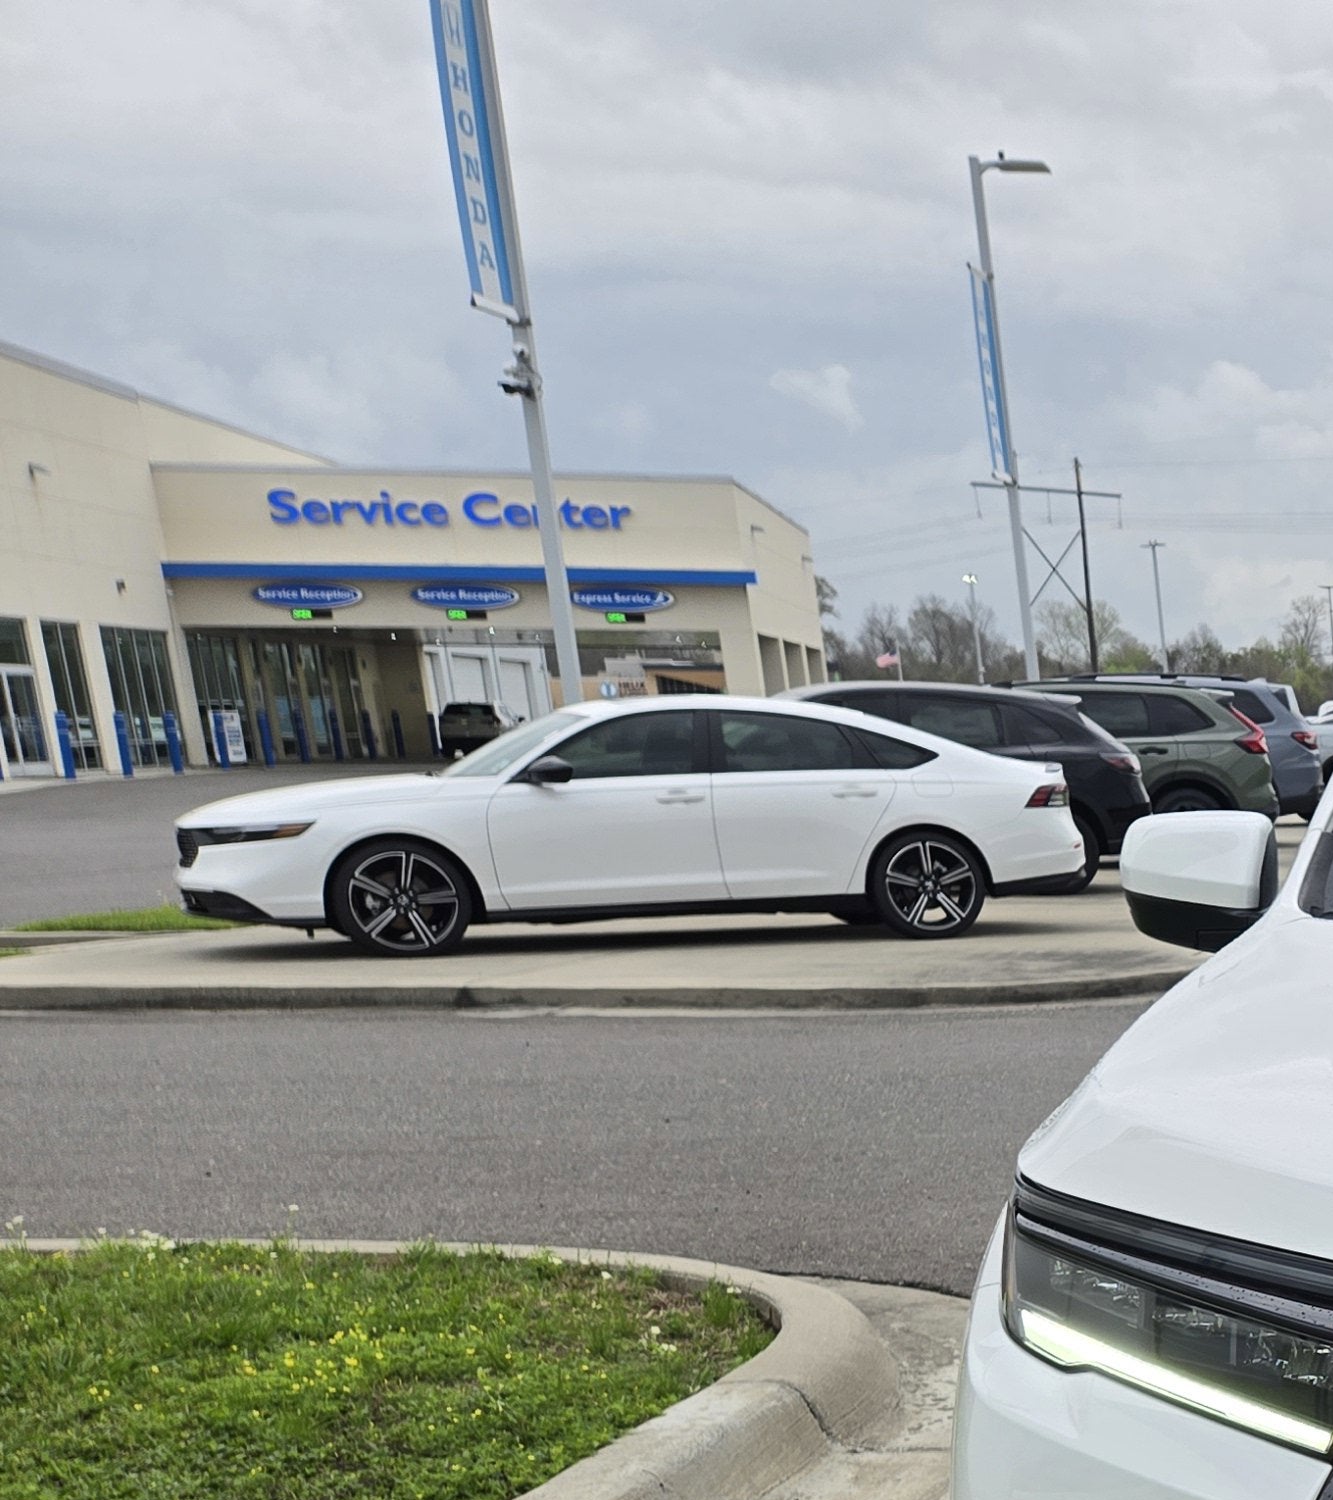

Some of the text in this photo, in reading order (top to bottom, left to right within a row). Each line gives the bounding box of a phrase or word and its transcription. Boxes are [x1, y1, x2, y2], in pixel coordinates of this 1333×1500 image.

[450, 63, 496, 271] HONDA
[266, 488, 632, 530] Service Ceter
[258, 587, 355, 601] Service Reception
[417, 588, 511, 602] Service Reception
[613, 592, 652, 603] Service
